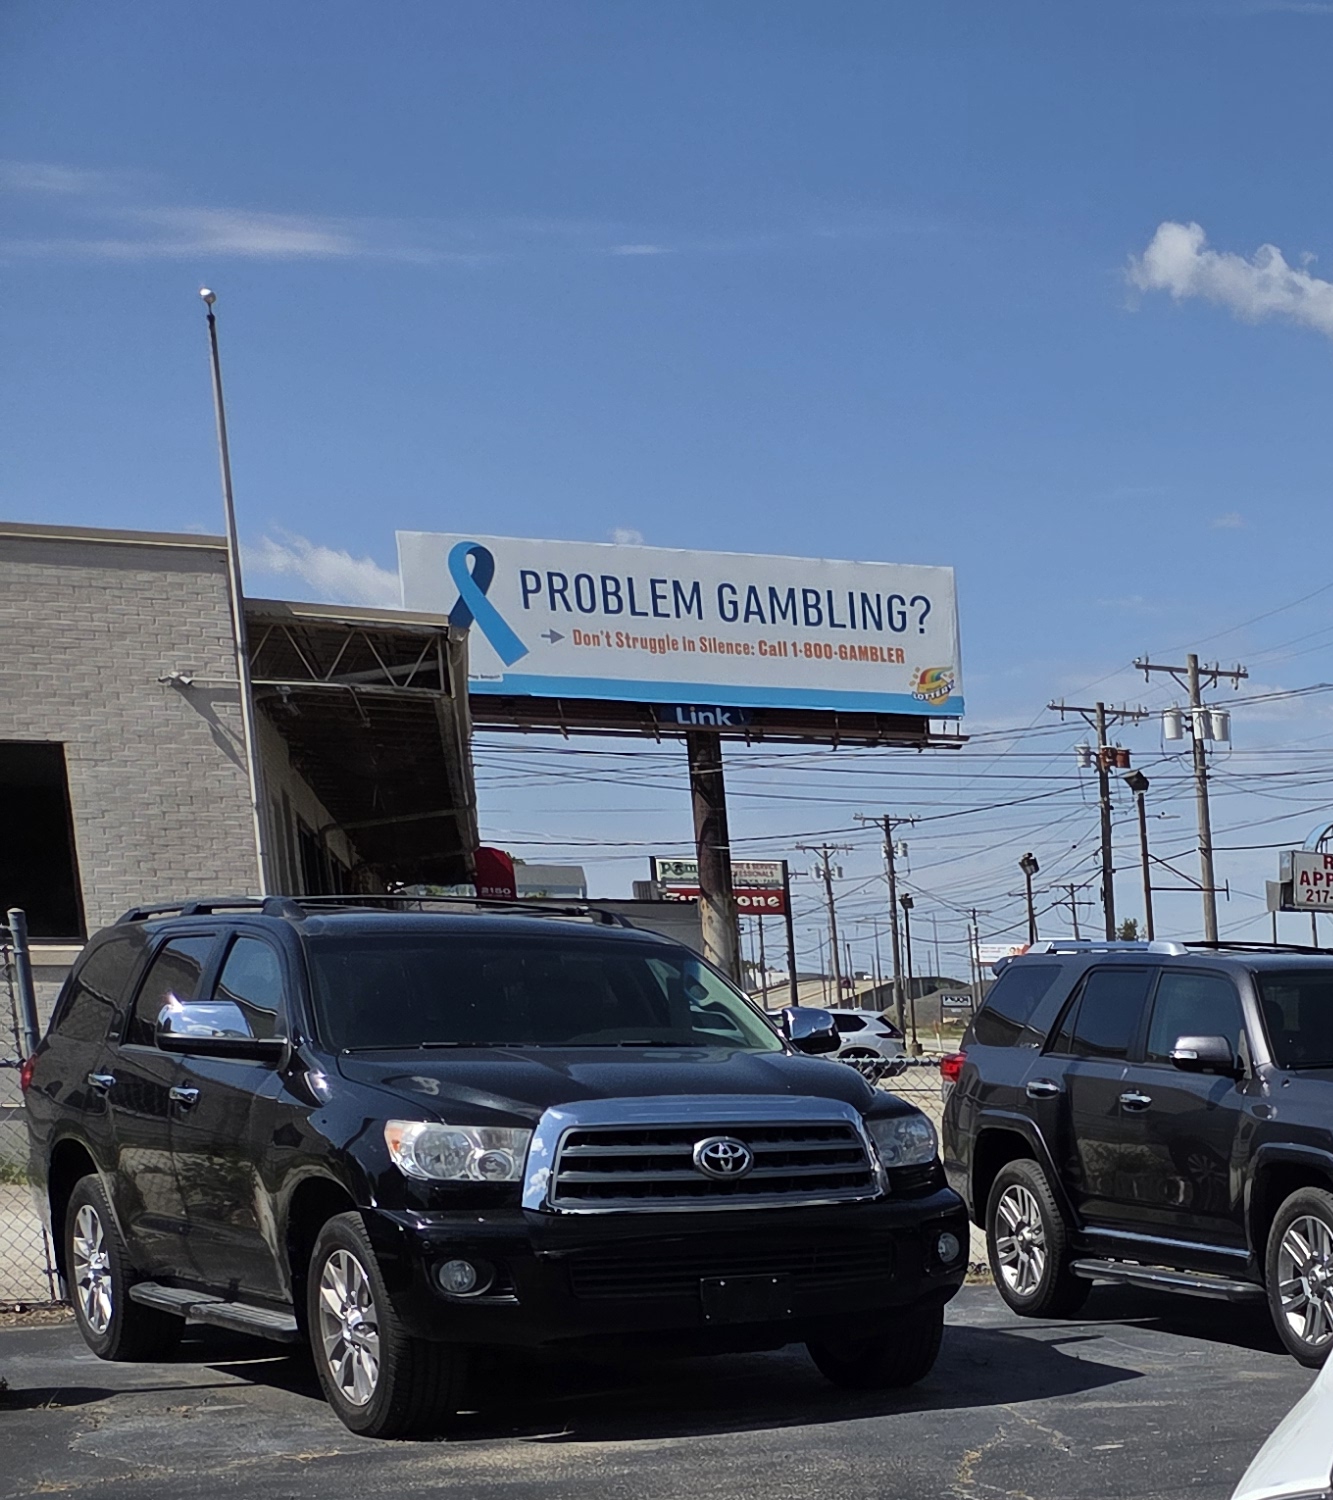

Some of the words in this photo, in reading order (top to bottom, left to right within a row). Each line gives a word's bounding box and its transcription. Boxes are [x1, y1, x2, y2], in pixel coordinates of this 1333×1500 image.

[520, 569, 703, 620] PROBLEM
[717, 582, 932, 634] GAMBLING?
[572, 629, 612, 647] Don't
[616, 631, 679, 654] Struggle
[699, 636, 755, 655] Silence:
[758, 639, 788, 657] Call
[791, 641, 905, 664] 1-800-GAMBLER
[912, 681, 954, 701] LOTTERY
[676, 706, 732, 727] Link
